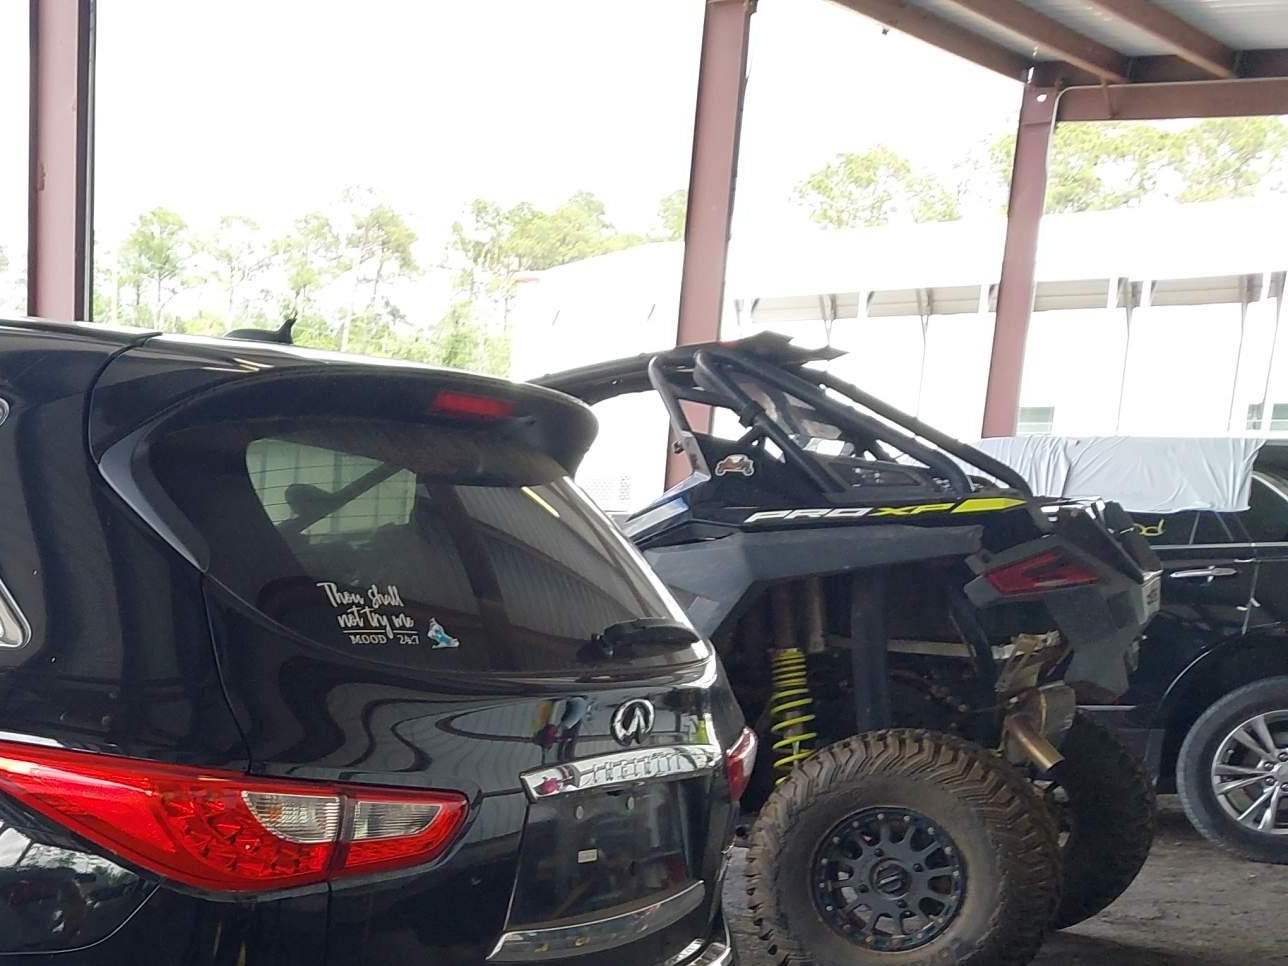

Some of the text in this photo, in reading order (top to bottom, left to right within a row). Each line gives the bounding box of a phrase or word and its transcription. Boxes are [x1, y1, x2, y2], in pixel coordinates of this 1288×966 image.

[744, 502, 955, 524] PRO XP
[316, 582, 365, 608] Thou
[337, 606, 414, 639] not try me
[349, 634, 388, 645] MOOD
